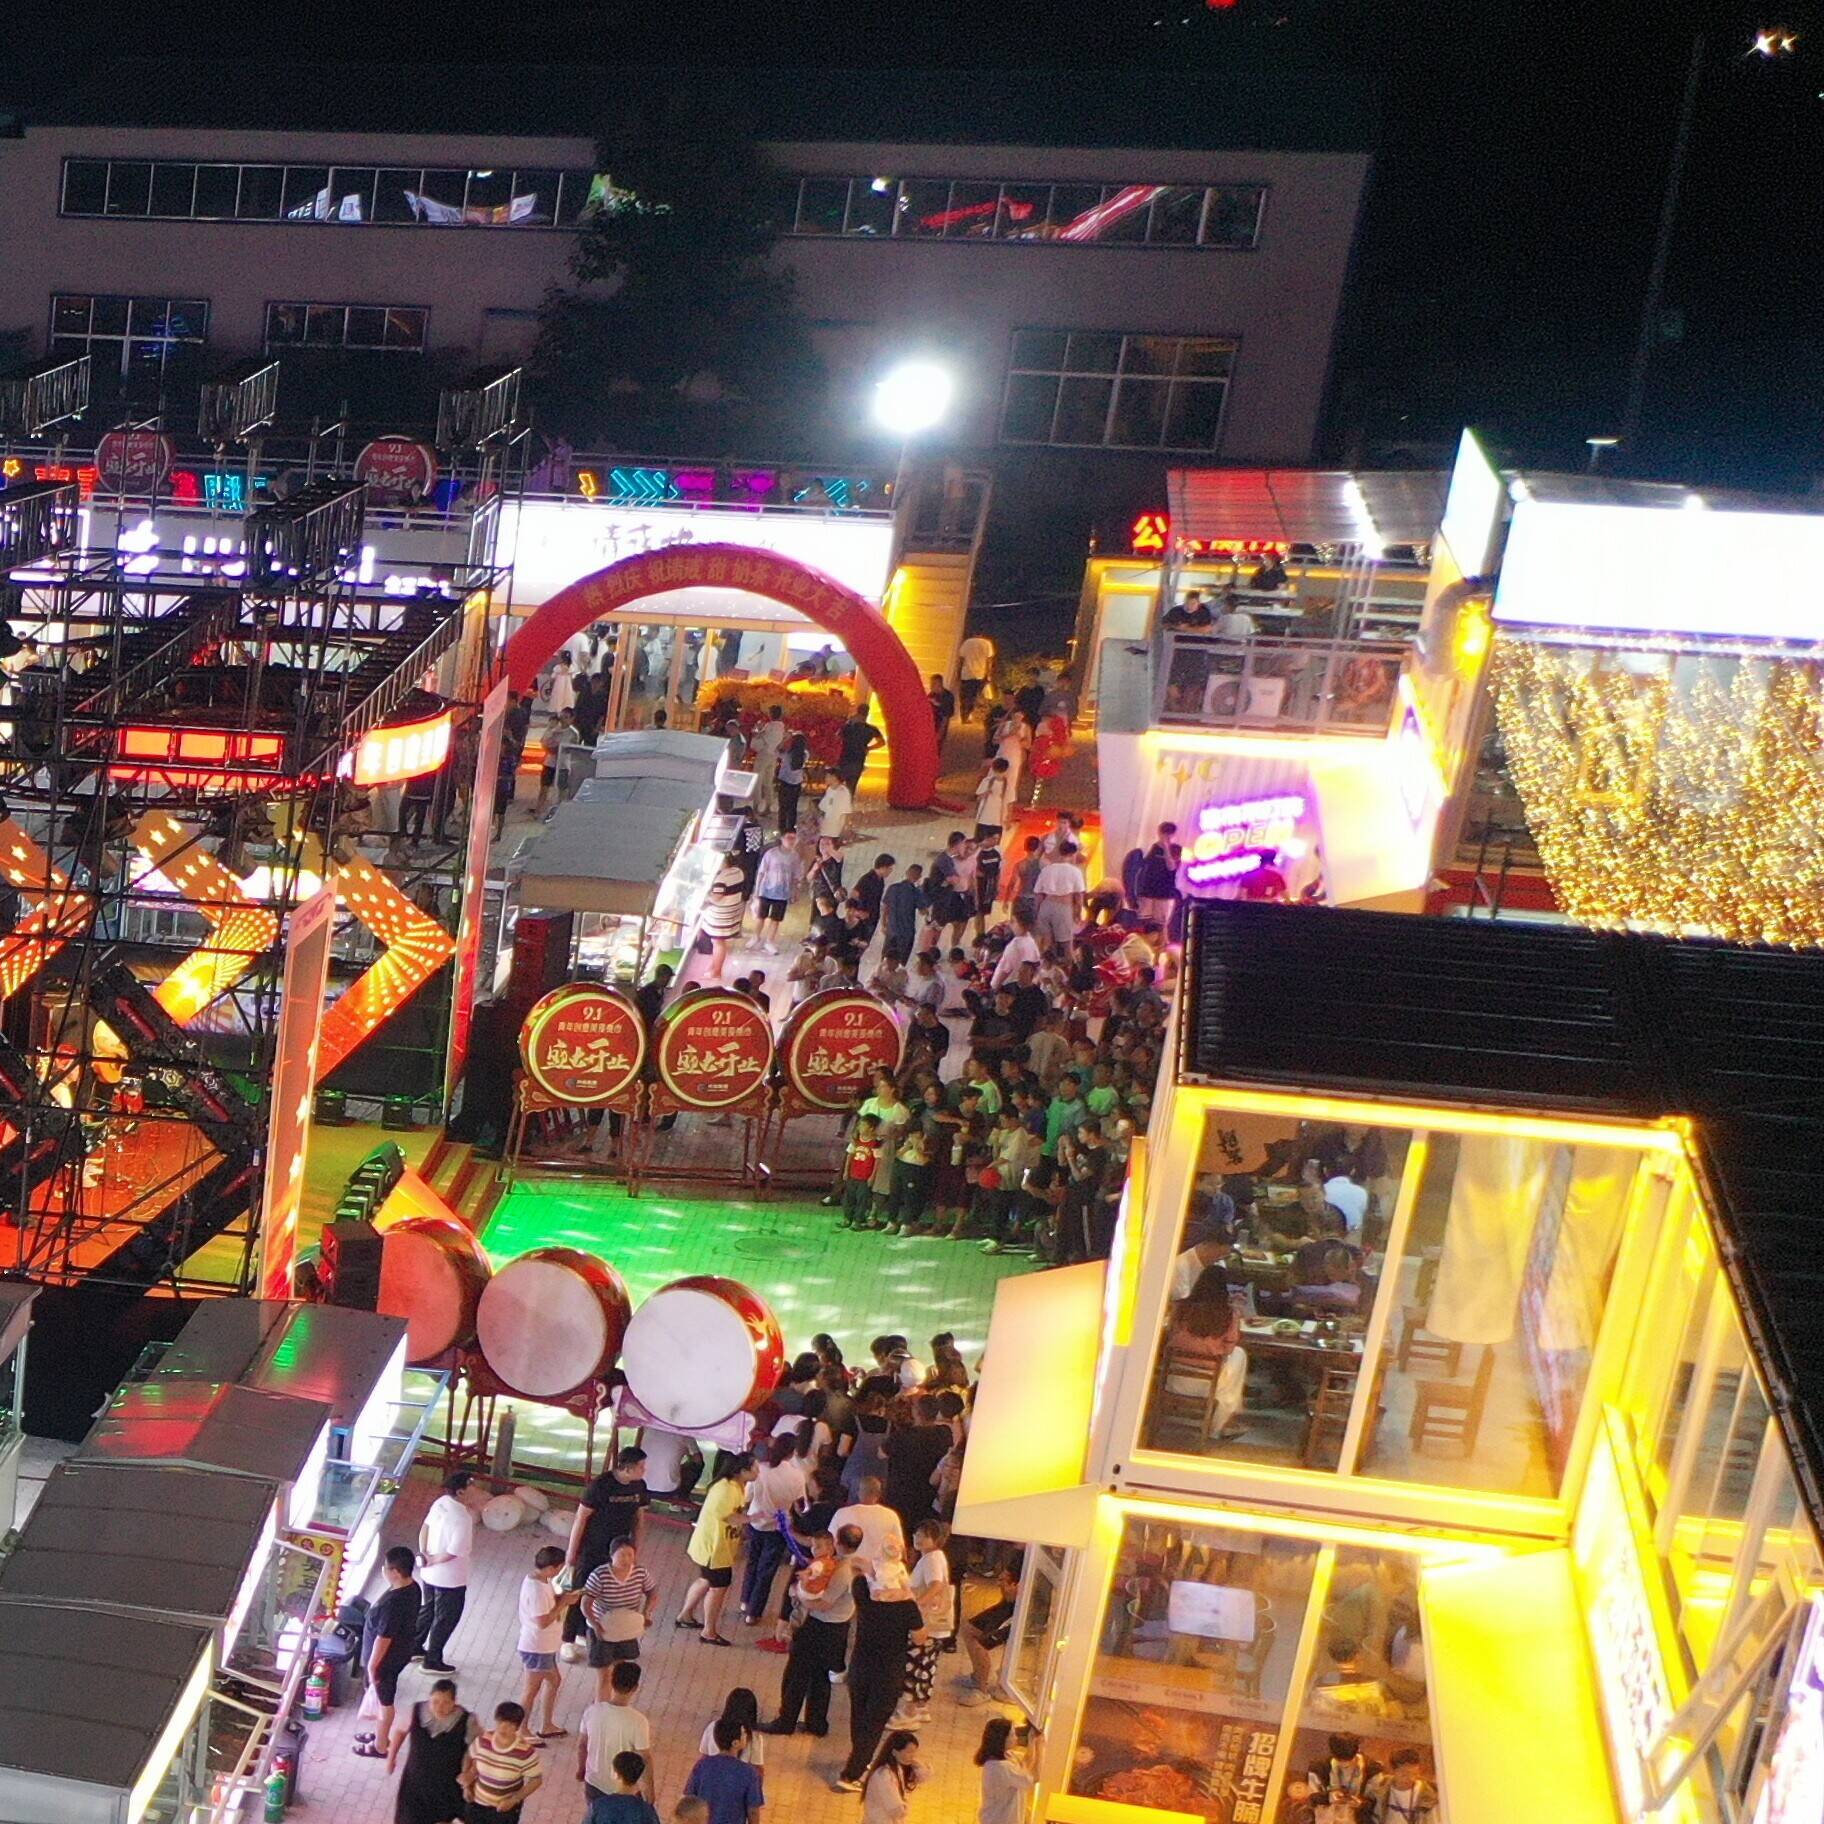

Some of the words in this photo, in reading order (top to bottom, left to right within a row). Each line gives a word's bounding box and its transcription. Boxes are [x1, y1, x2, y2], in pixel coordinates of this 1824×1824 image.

[583, 1005, 602, 1021] 9.1
[712, 1010, 732, 1025] 9.1
[844, 1011, 864, 1027] 9.1
[540, 1037, 631, 1074] 盛大开业
[672, 1041, 762, 1079] 盛大开业
